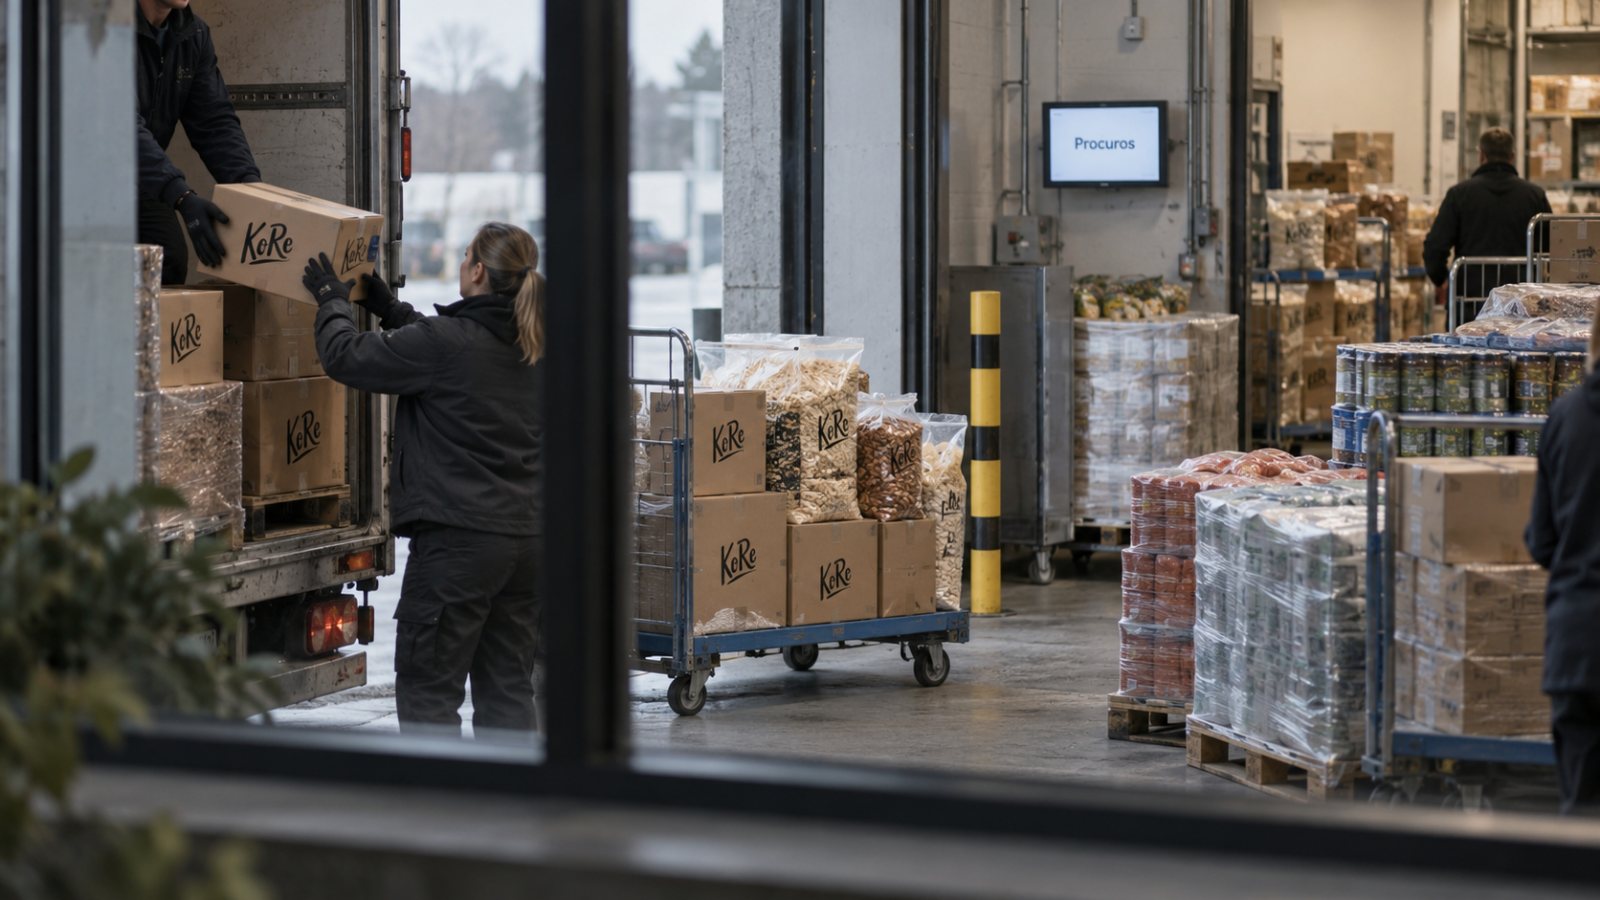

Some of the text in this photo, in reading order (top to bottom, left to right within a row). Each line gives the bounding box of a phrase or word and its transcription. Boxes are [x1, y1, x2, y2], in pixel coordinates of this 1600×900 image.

[1074, 137, 1135, 150] Procuros
[240, 222, 293, 265] KoRe
[170, 313, 201, 364] KoRe
[286, 410, 320, 465] KoRe
[712, 419, 744, 464] KoRe
[817, 409, 849, 451] KoRe
[720, 537, 757, 586] KoRe
[820, 558, 851, 600] KoRe
